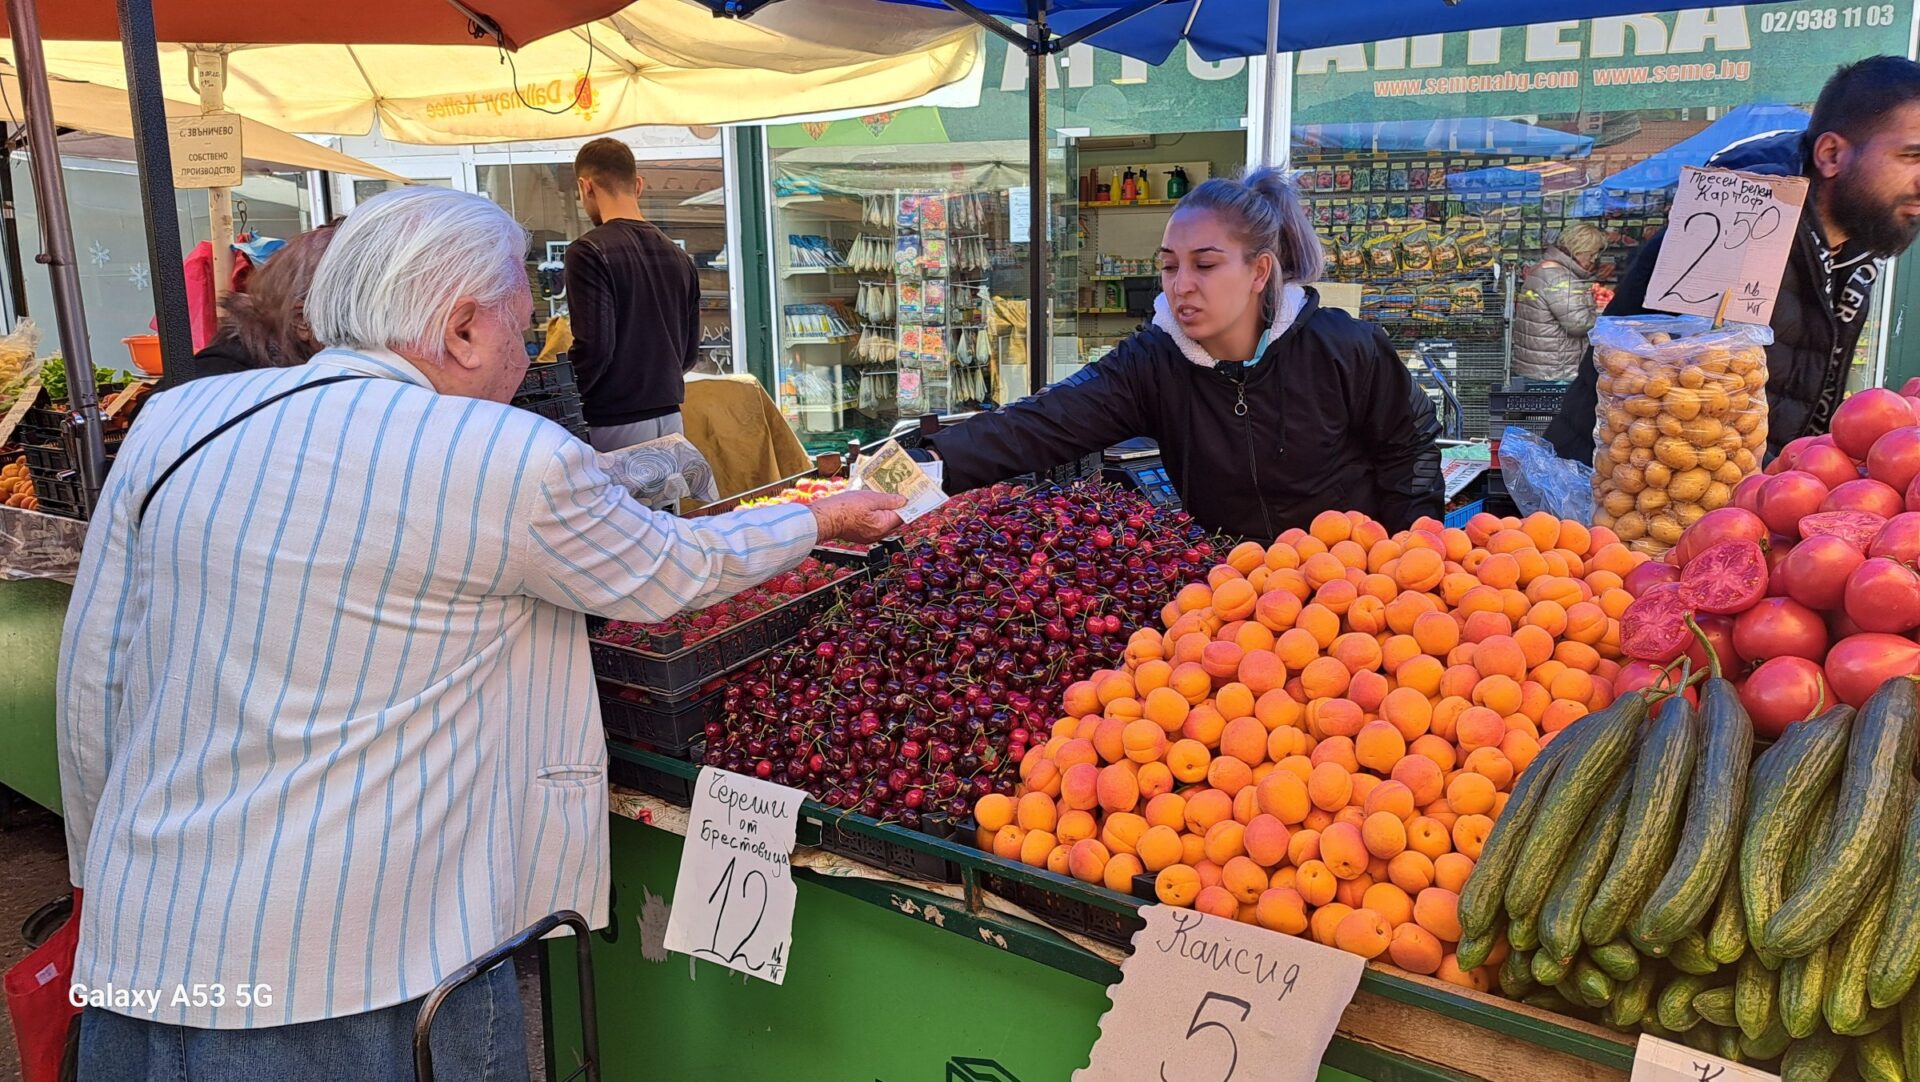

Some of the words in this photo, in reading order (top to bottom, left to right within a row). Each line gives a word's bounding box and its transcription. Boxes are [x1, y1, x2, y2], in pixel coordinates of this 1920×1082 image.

[1760, 11, 1837, 34] 02/938
[1841, 7, 1861, 28] 11
[1866, 5, 1895, 27] 03
[1373, 69, 1579, 98] www.semenabg.com
[1592, 59, 1750, 86] www.seme.bg
[187, 126, 234, 138] ЗВЪНИЧЕВО
[181, 165, 236, 177] ПРОИЗВОДСТВО
[188, 152, 229, 162] СОБСТВЕНО
[1689, 171, 1738, 189] Пресен
[1695, 185, 1763, 210] Картоф
[708, 771, 789, 825] Череши
[739, 819, 758, 834] от
[700, 819, 789, 878] Брестовица
[692, 856, 768, 971] 12
[1156, 910, 1300, 1001] Кайсия
[1160, 991, 1251, 1082] 5
